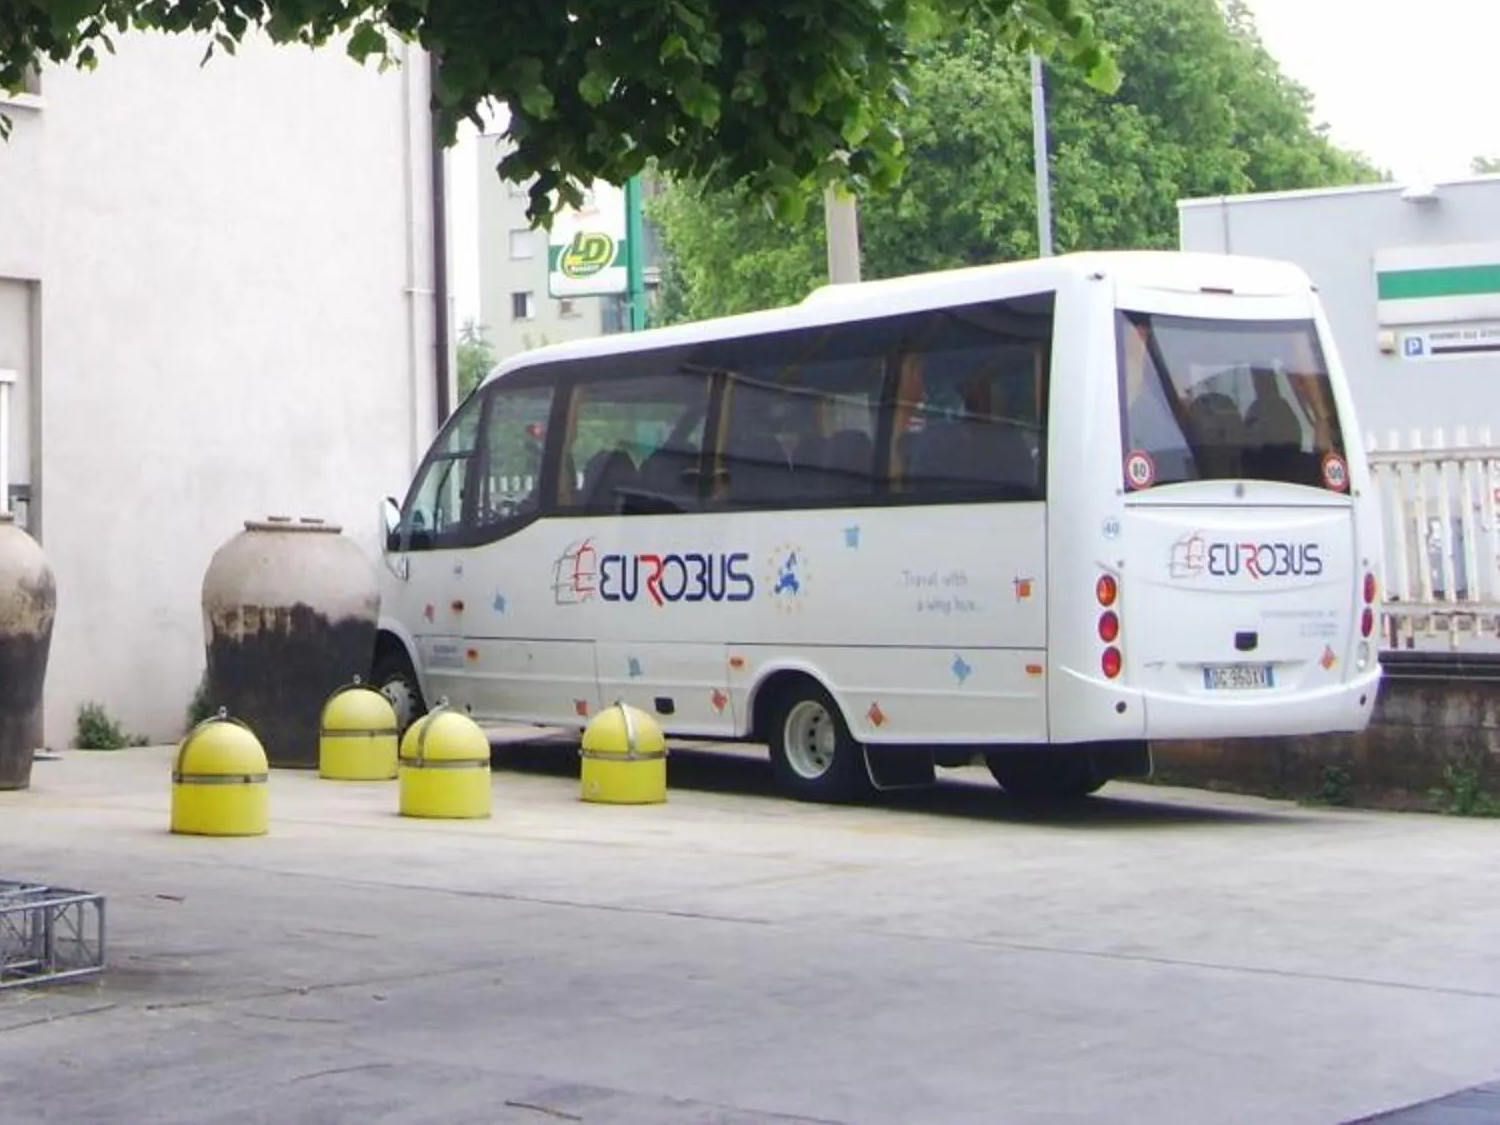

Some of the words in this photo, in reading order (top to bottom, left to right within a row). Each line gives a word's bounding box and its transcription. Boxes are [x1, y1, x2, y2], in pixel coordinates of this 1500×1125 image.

[1132, 462, 1147, 478] 80
[1208, 543, 1323, 579] EUROBUS
[600, 553, 755, 607] EUROBUS
